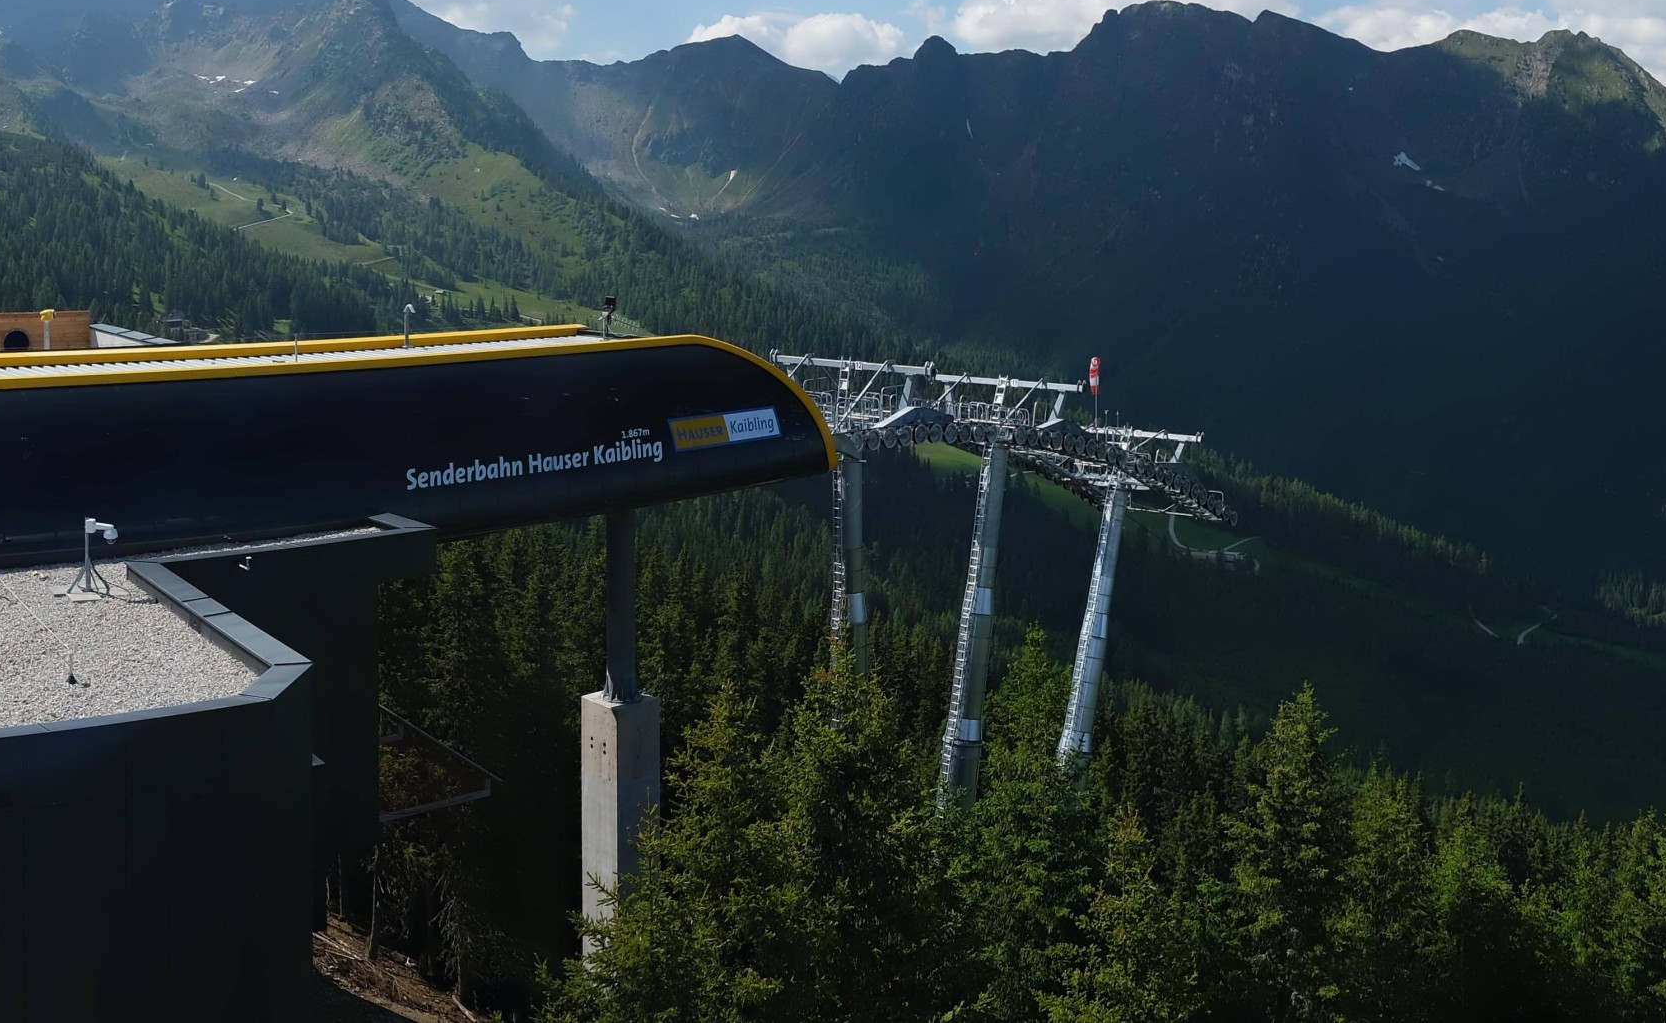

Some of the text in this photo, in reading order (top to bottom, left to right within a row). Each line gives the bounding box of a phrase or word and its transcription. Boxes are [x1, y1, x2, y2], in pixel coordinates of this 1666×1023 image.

[621, 428, 650, 440] 1.867m
[677, 416, 775, 442] HAUSER Kaibling
[406, 438, 663, 491] Senderbahn Hauser Kaibling
